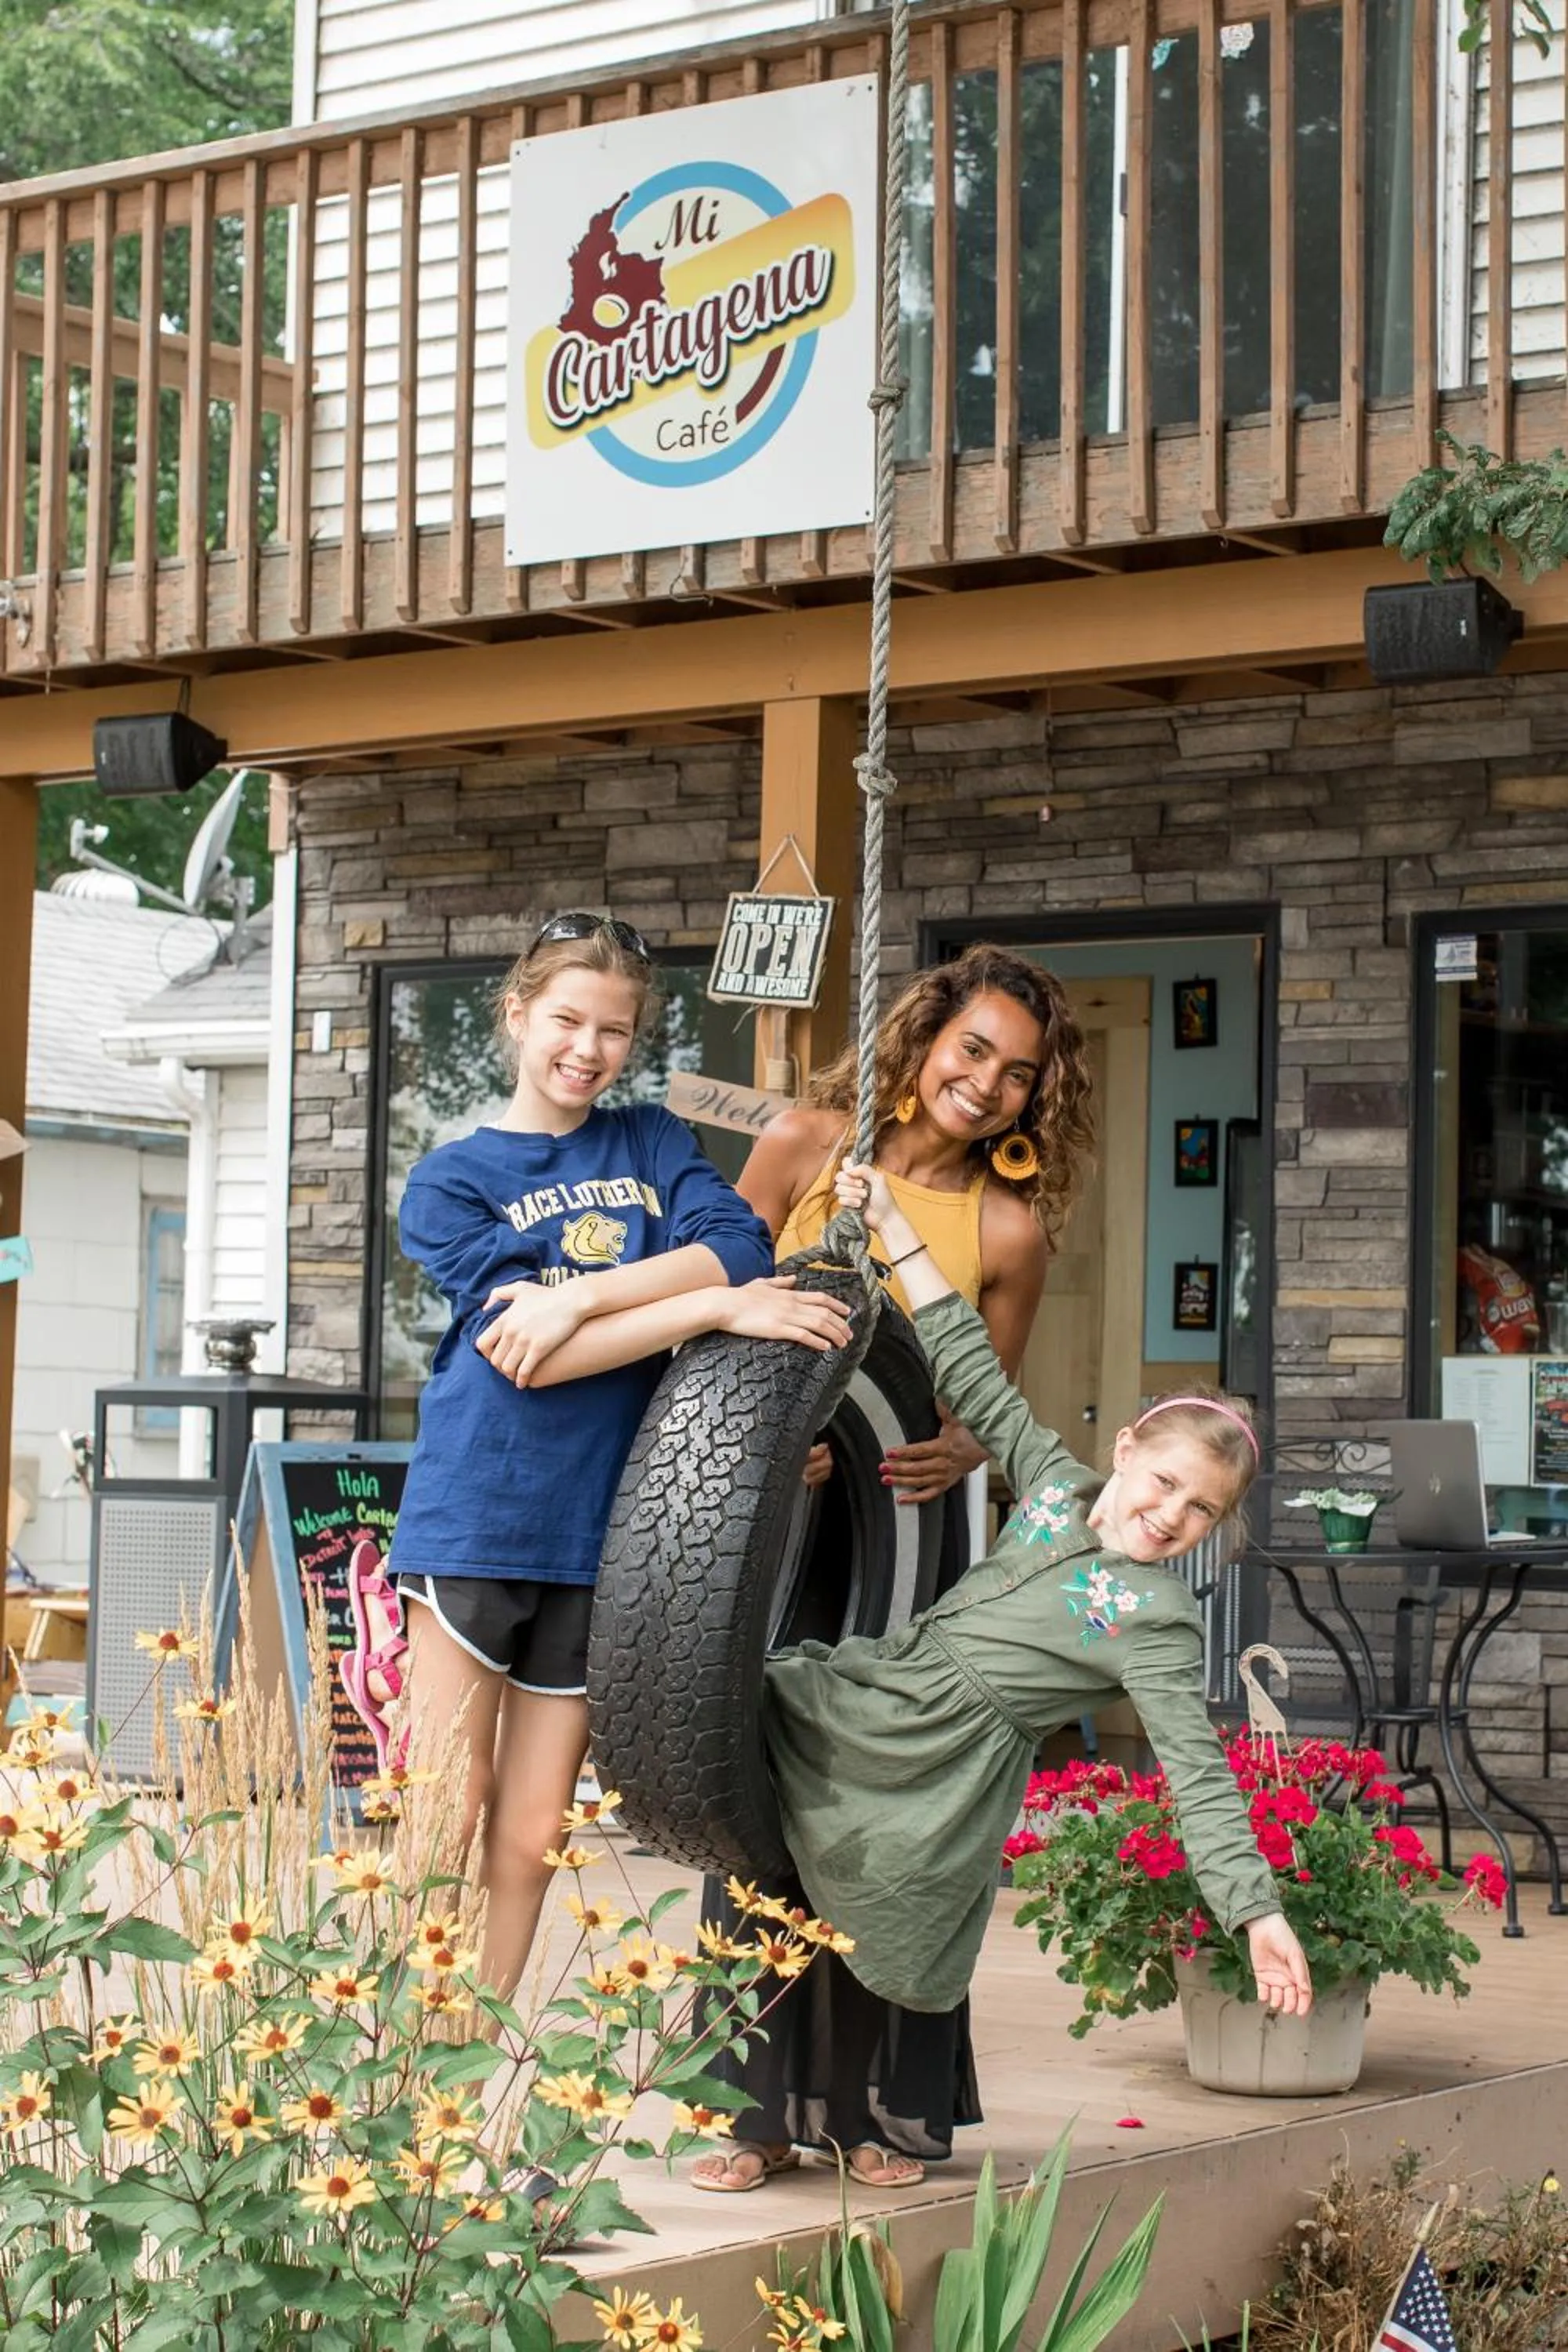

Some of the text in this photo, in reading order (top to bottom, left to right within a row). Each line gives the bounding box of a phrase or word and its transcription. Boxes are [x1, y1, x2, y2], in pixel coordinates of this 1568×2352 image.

[653, 196, 720, 251] Mi
[548, 246, 833, 423] Cartagena
[657, 406, 731, 452] Café
[732, 902, 767, 924] COME
[766, 904, 782, 924] IN
[722, 923, 820, 978] OPEN
[716, 972, 810, 999] AND AWESOME
[501, 1187, 564, 1233] RACE
